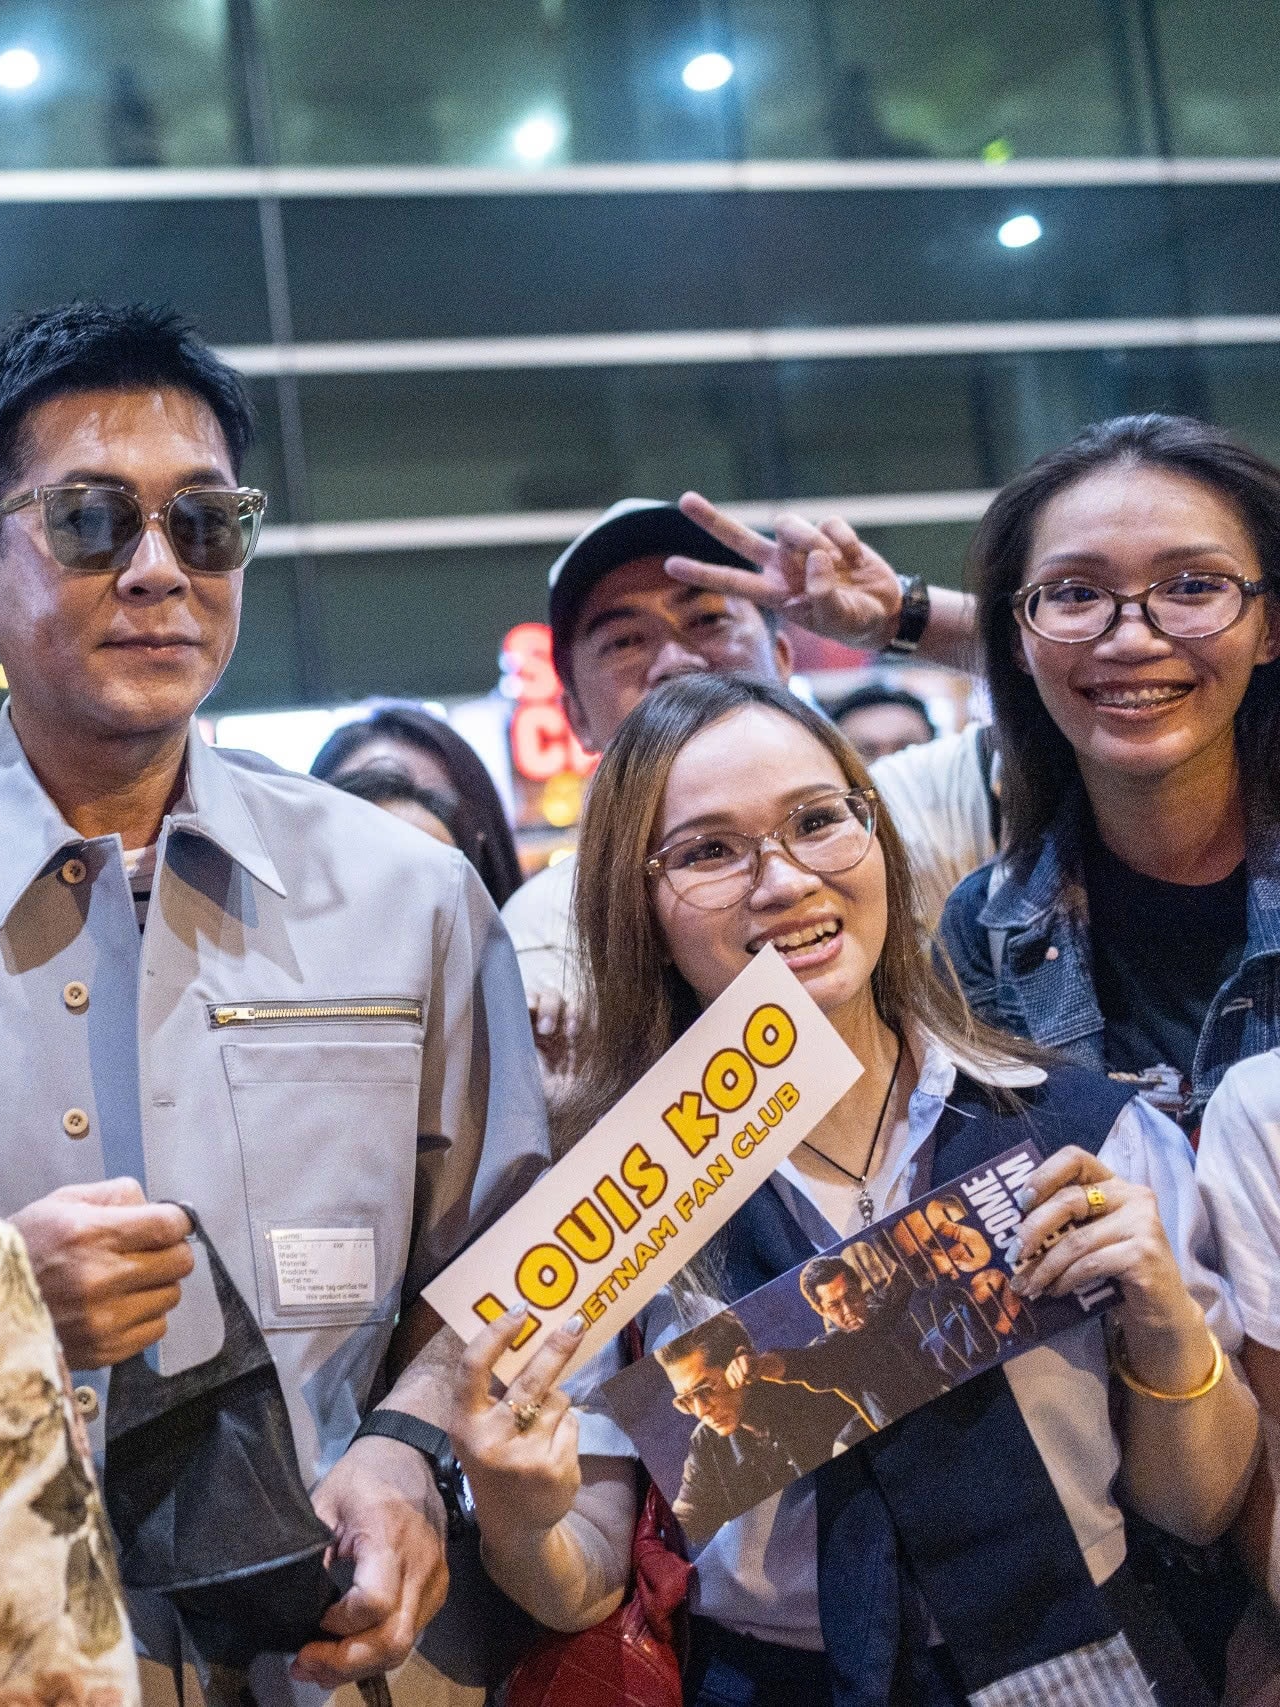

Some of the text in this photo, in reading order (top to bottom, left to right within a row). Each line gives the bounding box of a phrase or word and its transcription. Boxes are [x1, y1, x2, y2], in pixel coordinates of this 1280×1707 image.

[473, 1003, 797, 1351] LOUIS KOO
[674, 1154, 733, 1222] FAN
[731, 1082, 800, 1159] CLUB
[840, 1195, 992, 1295] OUIS
